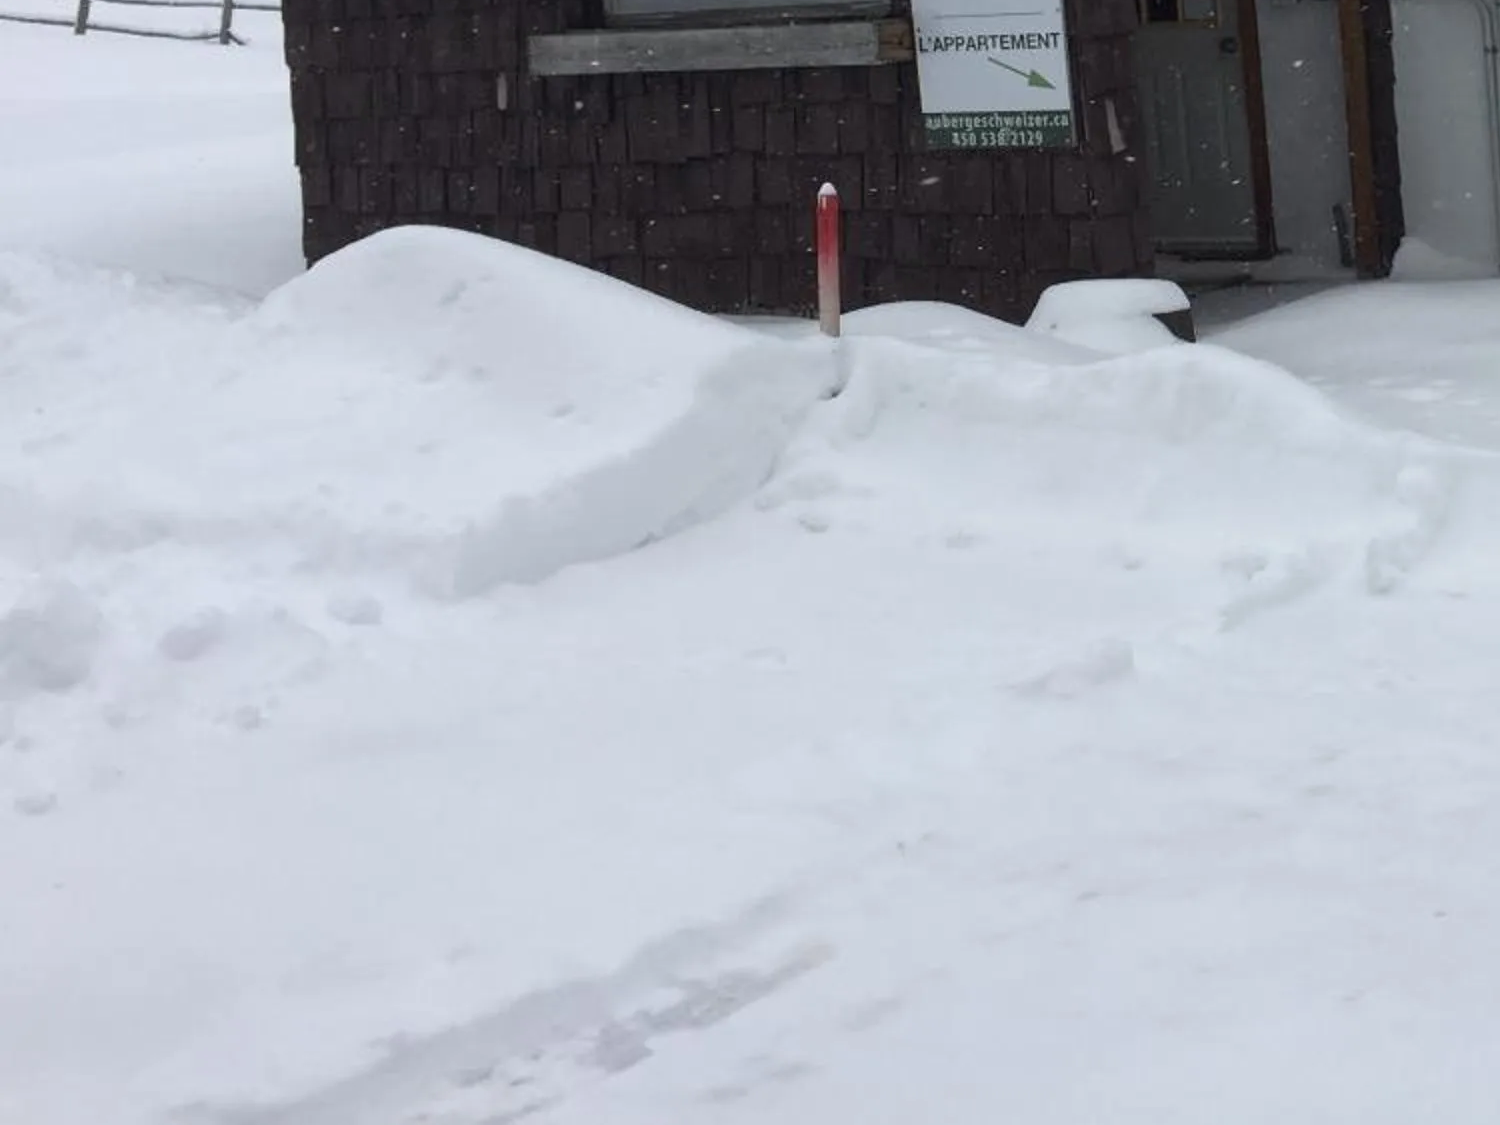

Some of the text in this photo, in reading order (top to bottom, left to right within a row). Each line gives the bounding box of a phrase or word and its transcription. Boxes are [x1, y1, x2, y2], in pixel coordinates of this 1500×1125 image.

[919, 32, 1061, 53] L'APPARTEMENT
[925, 113, 1070, 132] aubergeschweizer.ca
[951, 132, 977, 146] 450
[1010, 130, 1044, 146] 2129
